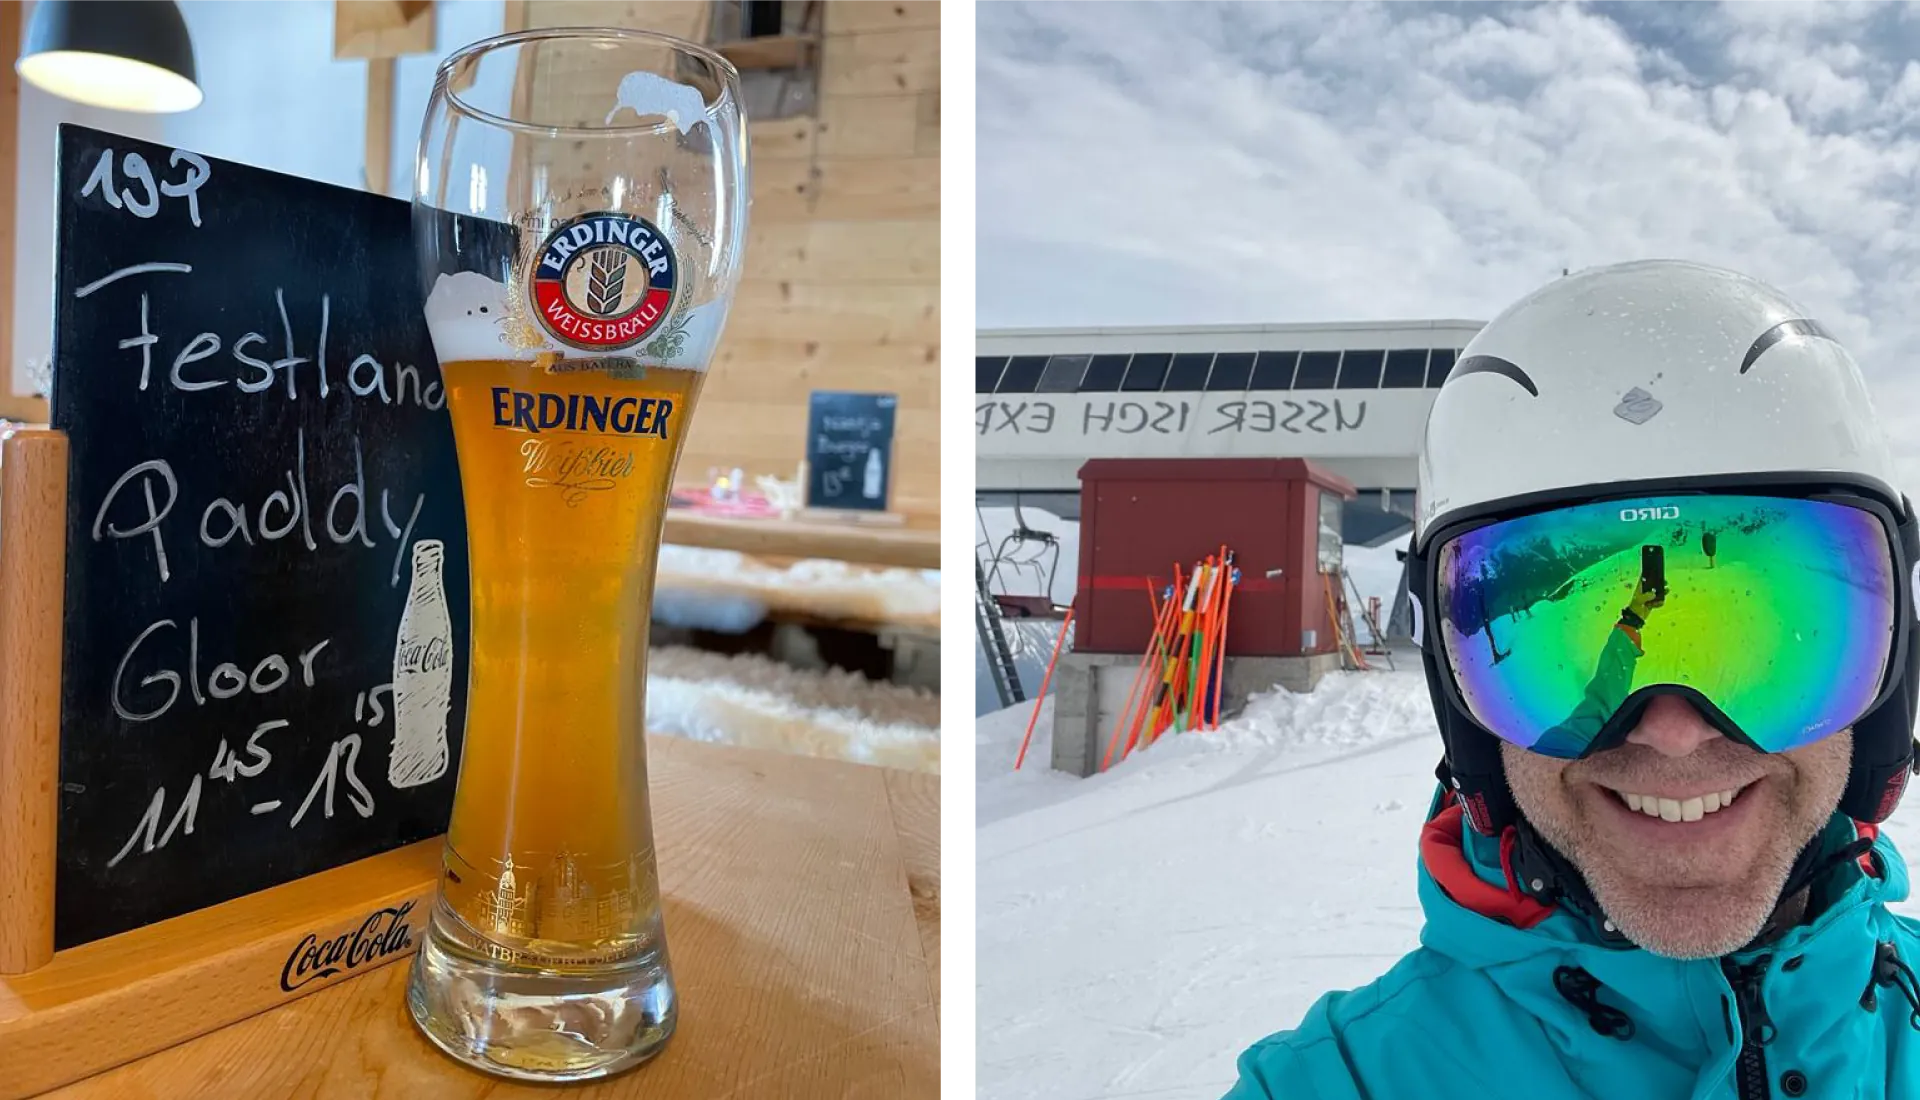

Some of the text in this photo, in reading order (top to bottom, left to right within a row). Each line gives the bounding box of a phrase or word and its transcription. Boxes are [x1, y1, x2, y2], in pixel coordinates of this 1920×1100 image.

[542, 219, 668, 278] ERDINGER
[547, 298, 659, 340] WEISSBRÄU
[491, 387, 673, 439] ERDINGER
[92, 428, 425, 587] Paddy
[112, 616, 330, 721] Gloor
